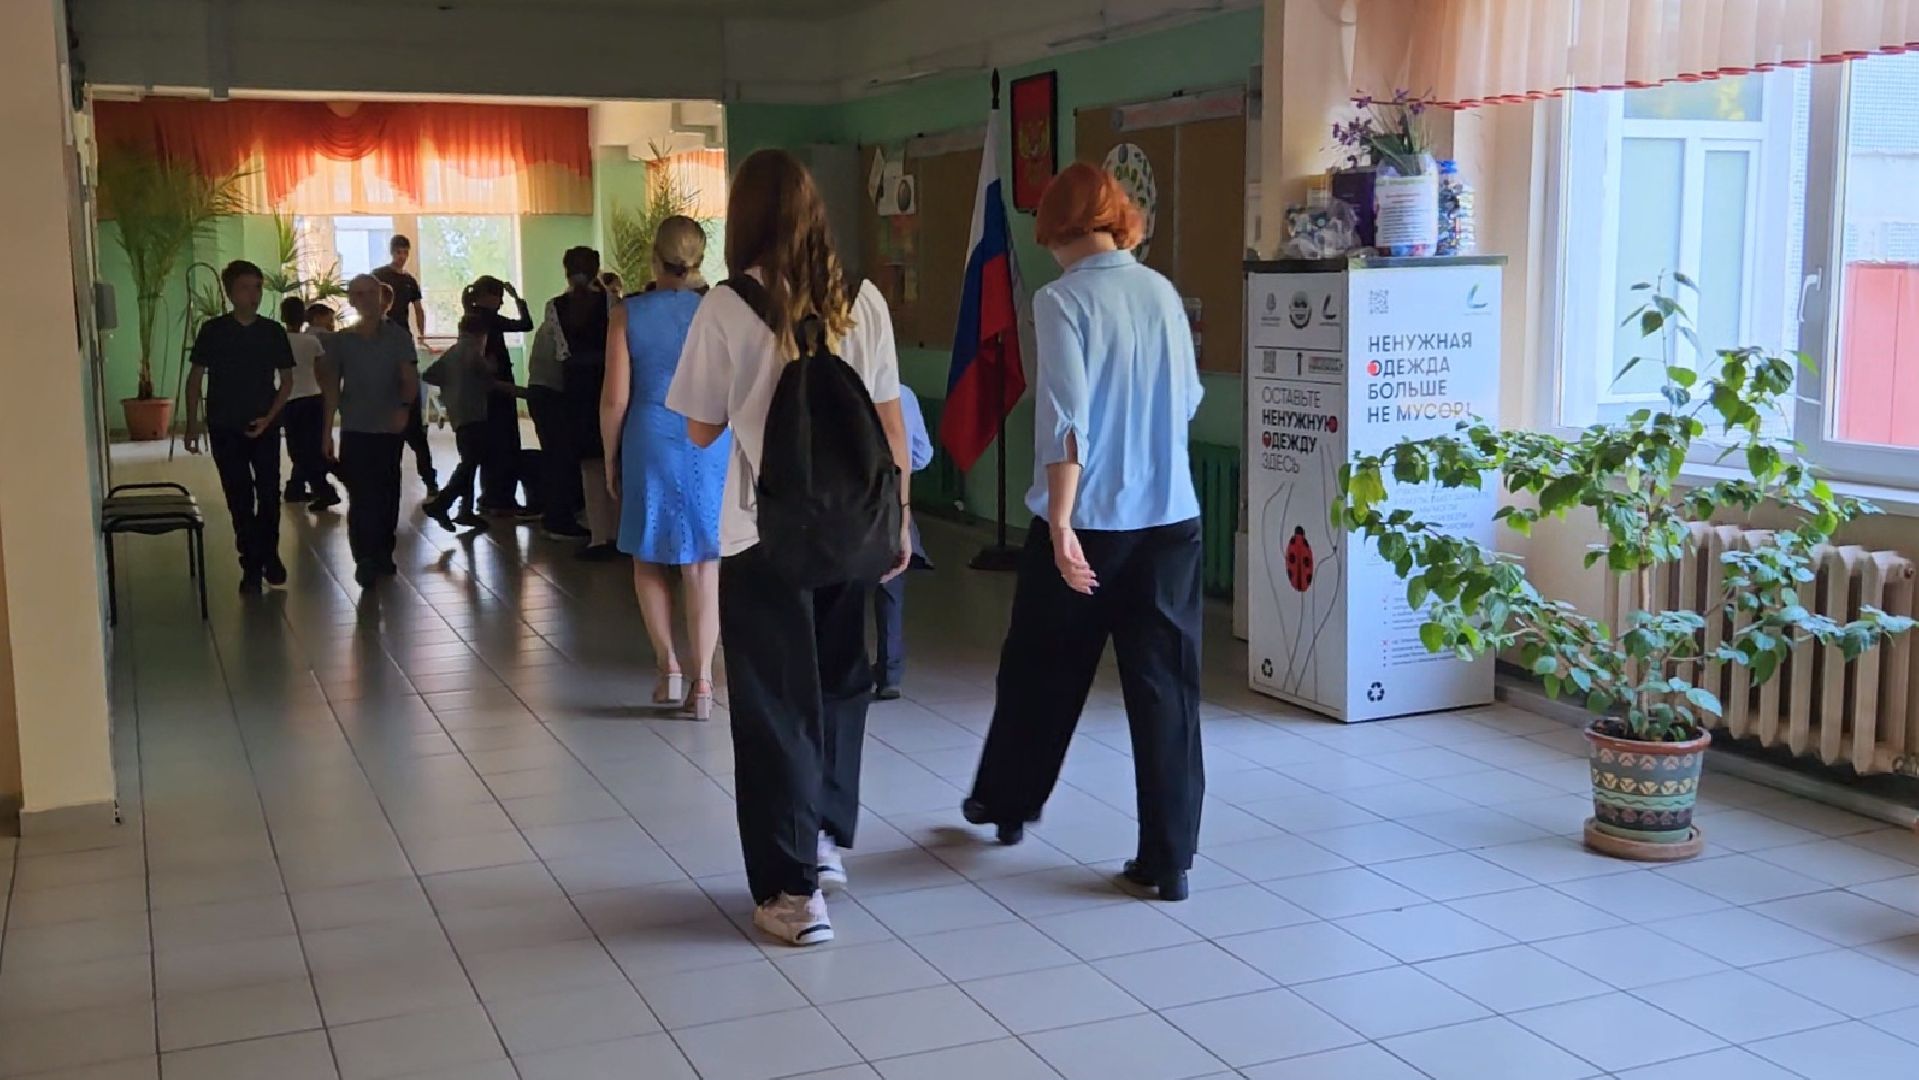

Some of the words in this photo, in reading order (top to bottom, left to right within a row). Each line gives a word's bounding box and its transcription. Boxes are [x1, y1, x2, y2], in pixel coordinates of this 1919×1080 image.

[1368, 332, 1472, 352] НЕНУЖНАЯ
[1367, 356, 1450, 378] ОДЕЖДА
[1262, 386, 1321, 408] ОСТАВЬТЕ
[1368, 379, 1447, 400] БОЛЬШЕ
[1262, 409, 1338, 433] НЕНУЖНУЮ
[1368, 406, 1390, 423] НЕ
[1262, 431, 1317, 454] ОДЕЖДУ
[1262, 452, 1300, 474] ЗДЕСЬ
